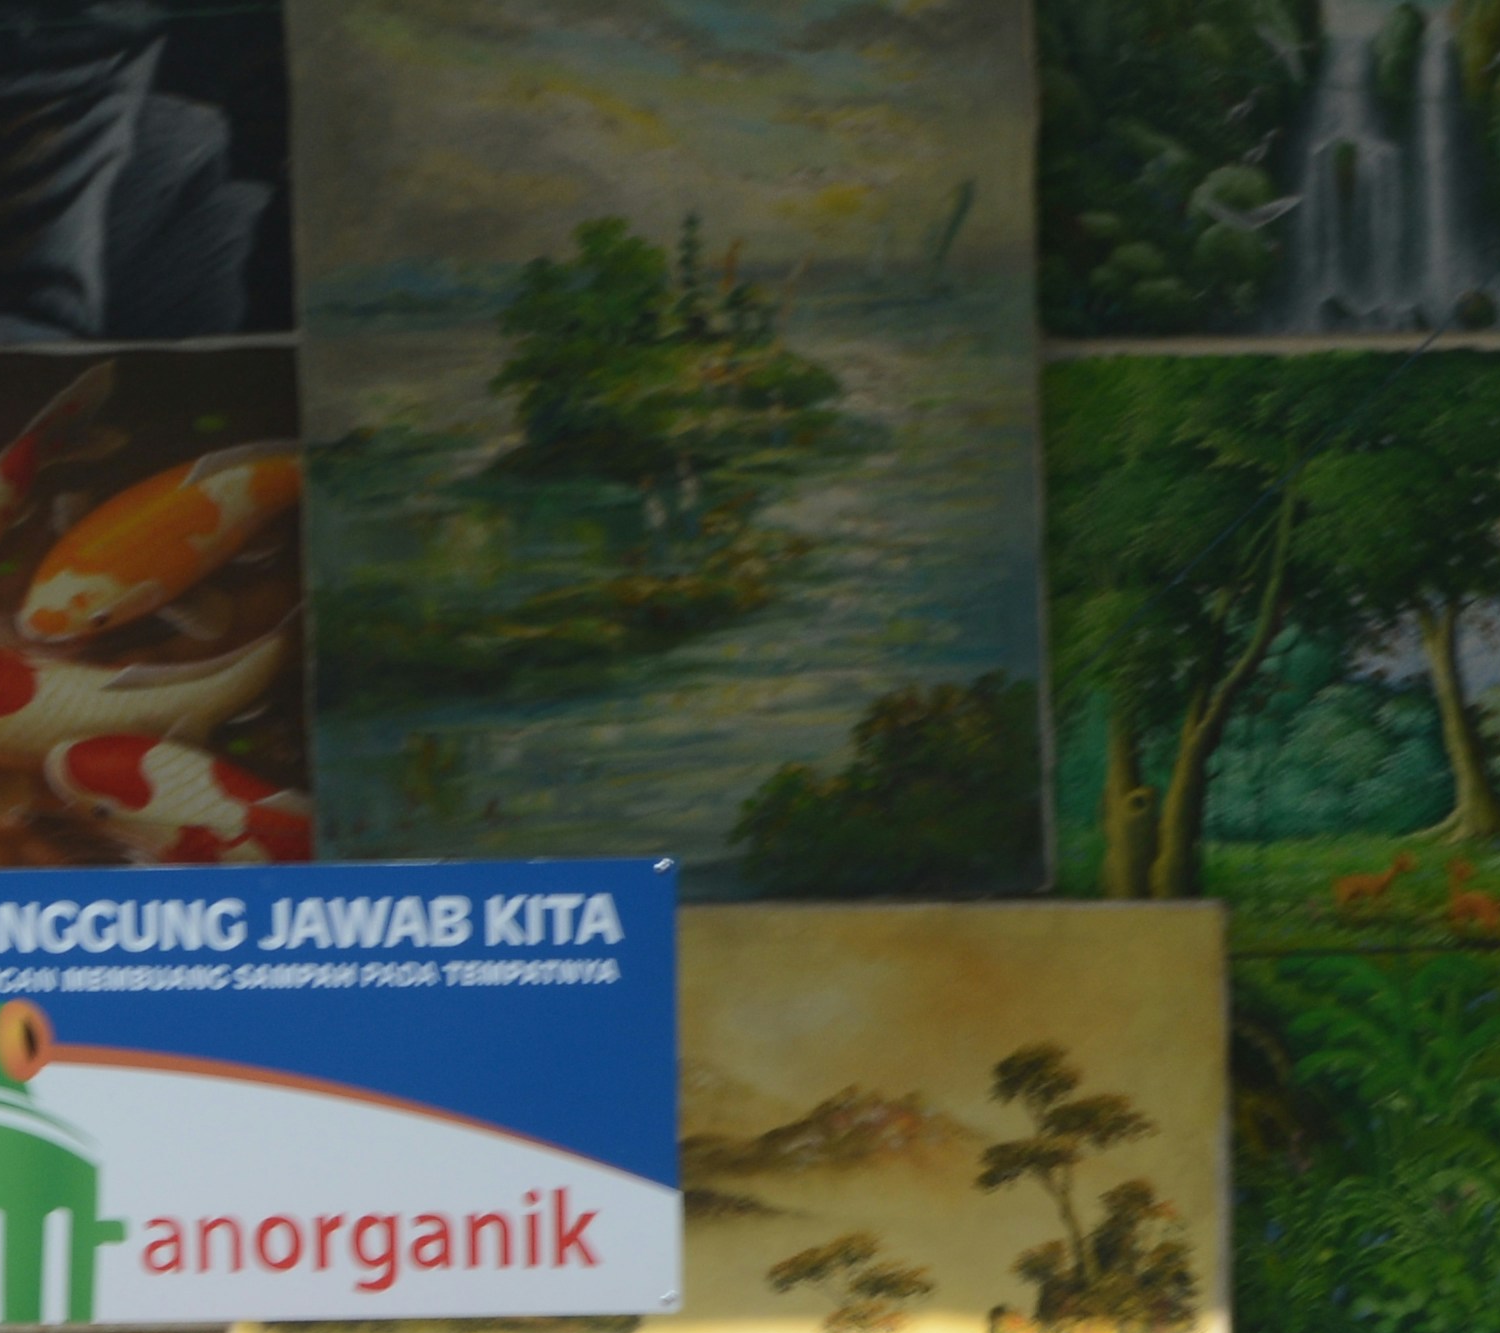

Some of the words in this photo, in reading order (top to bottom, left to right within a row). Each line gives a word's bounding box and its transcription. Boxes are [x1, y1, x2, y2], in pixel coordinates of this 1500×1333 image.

[258, 895, 473, 951] JAWAB
[484, 893, 625, 947] KITA
[61, 964, 232, 992] MEMBUANG
[233, 962, 358, 989] SAMPAH
[360, 961, 441, 987] PADA
[443, 958, 621, 986] TEMPATNYA
[139, 1186, 601, 1292] anorganik
